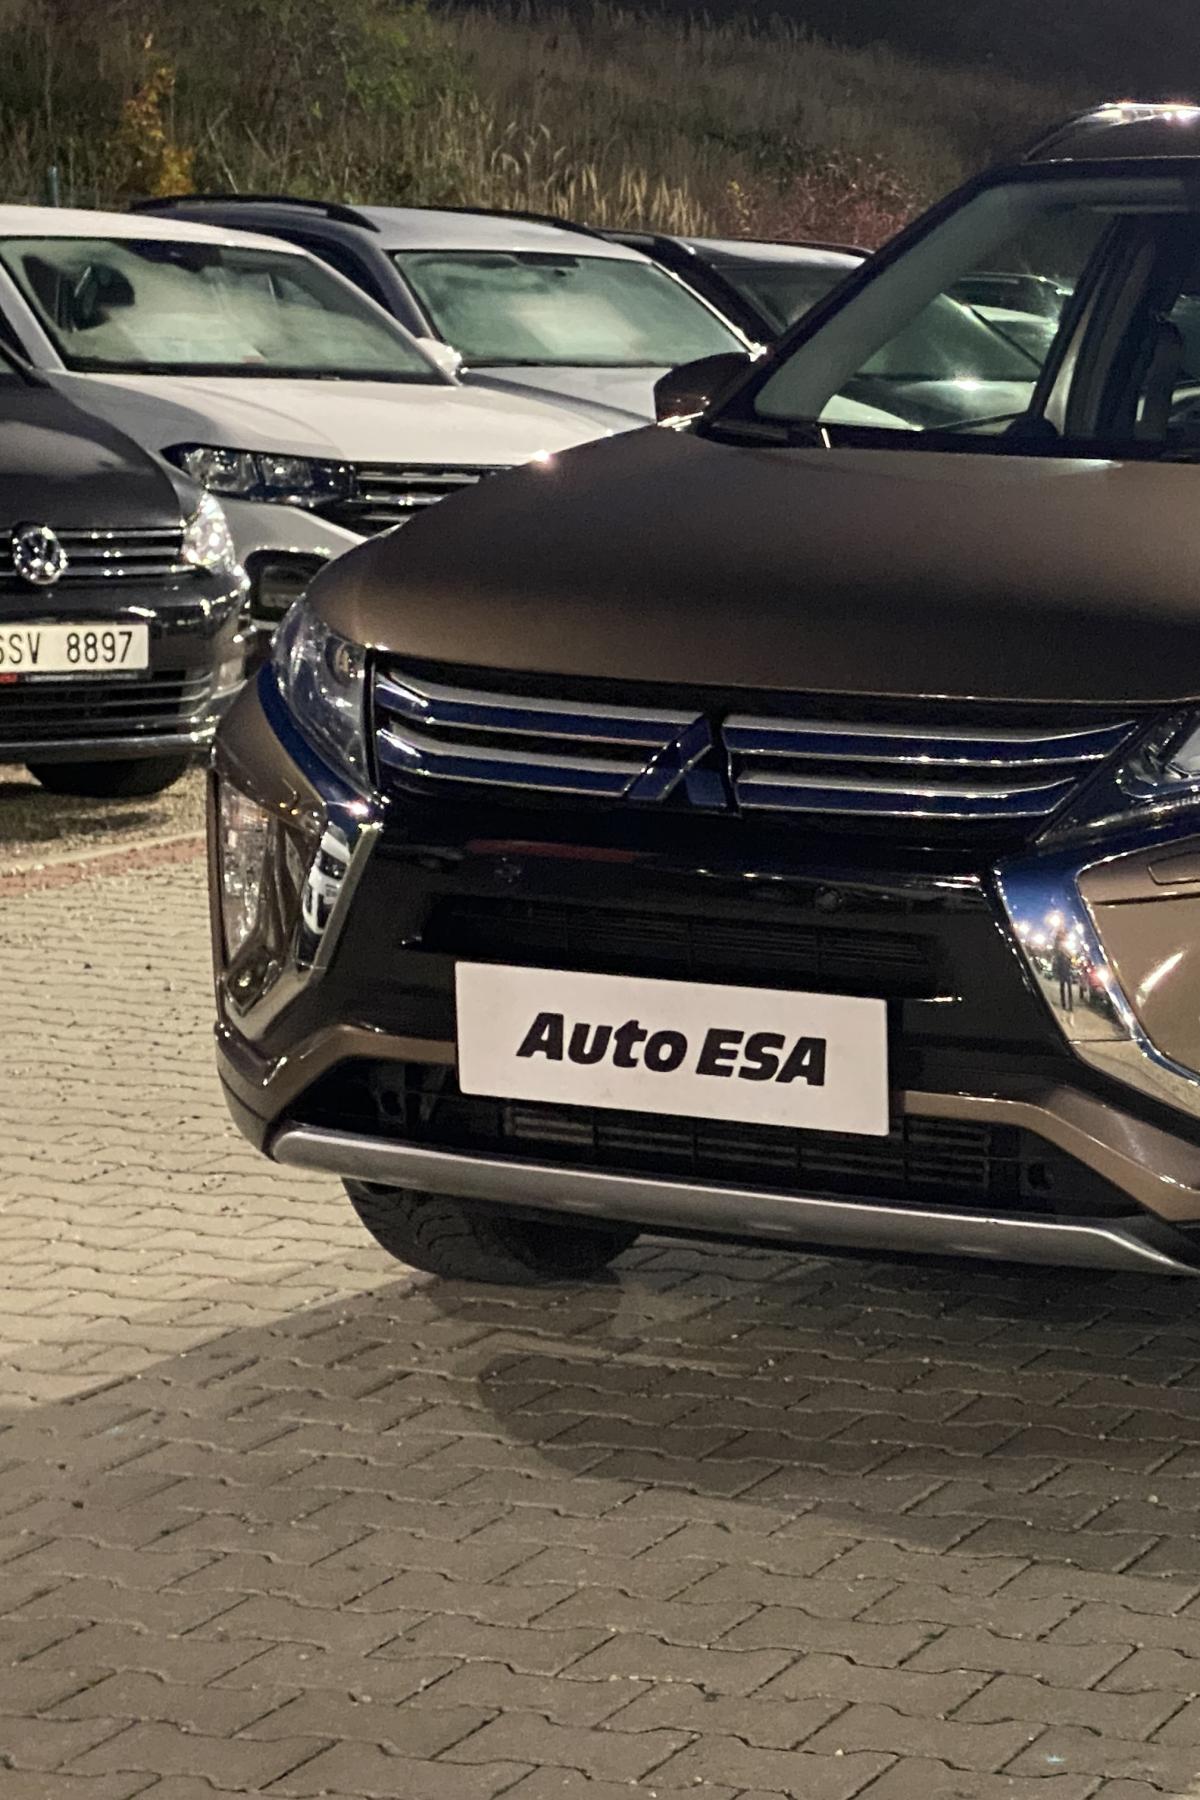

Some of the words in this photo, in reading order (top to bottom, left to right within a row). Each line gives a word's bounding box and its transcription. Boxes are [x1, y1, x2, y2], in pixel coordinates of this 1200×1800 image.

[66, 631, 133, 664] 8897
[516, 1012, 688, 1073] Auto
[696, 1028, 827, 1087] ESA
